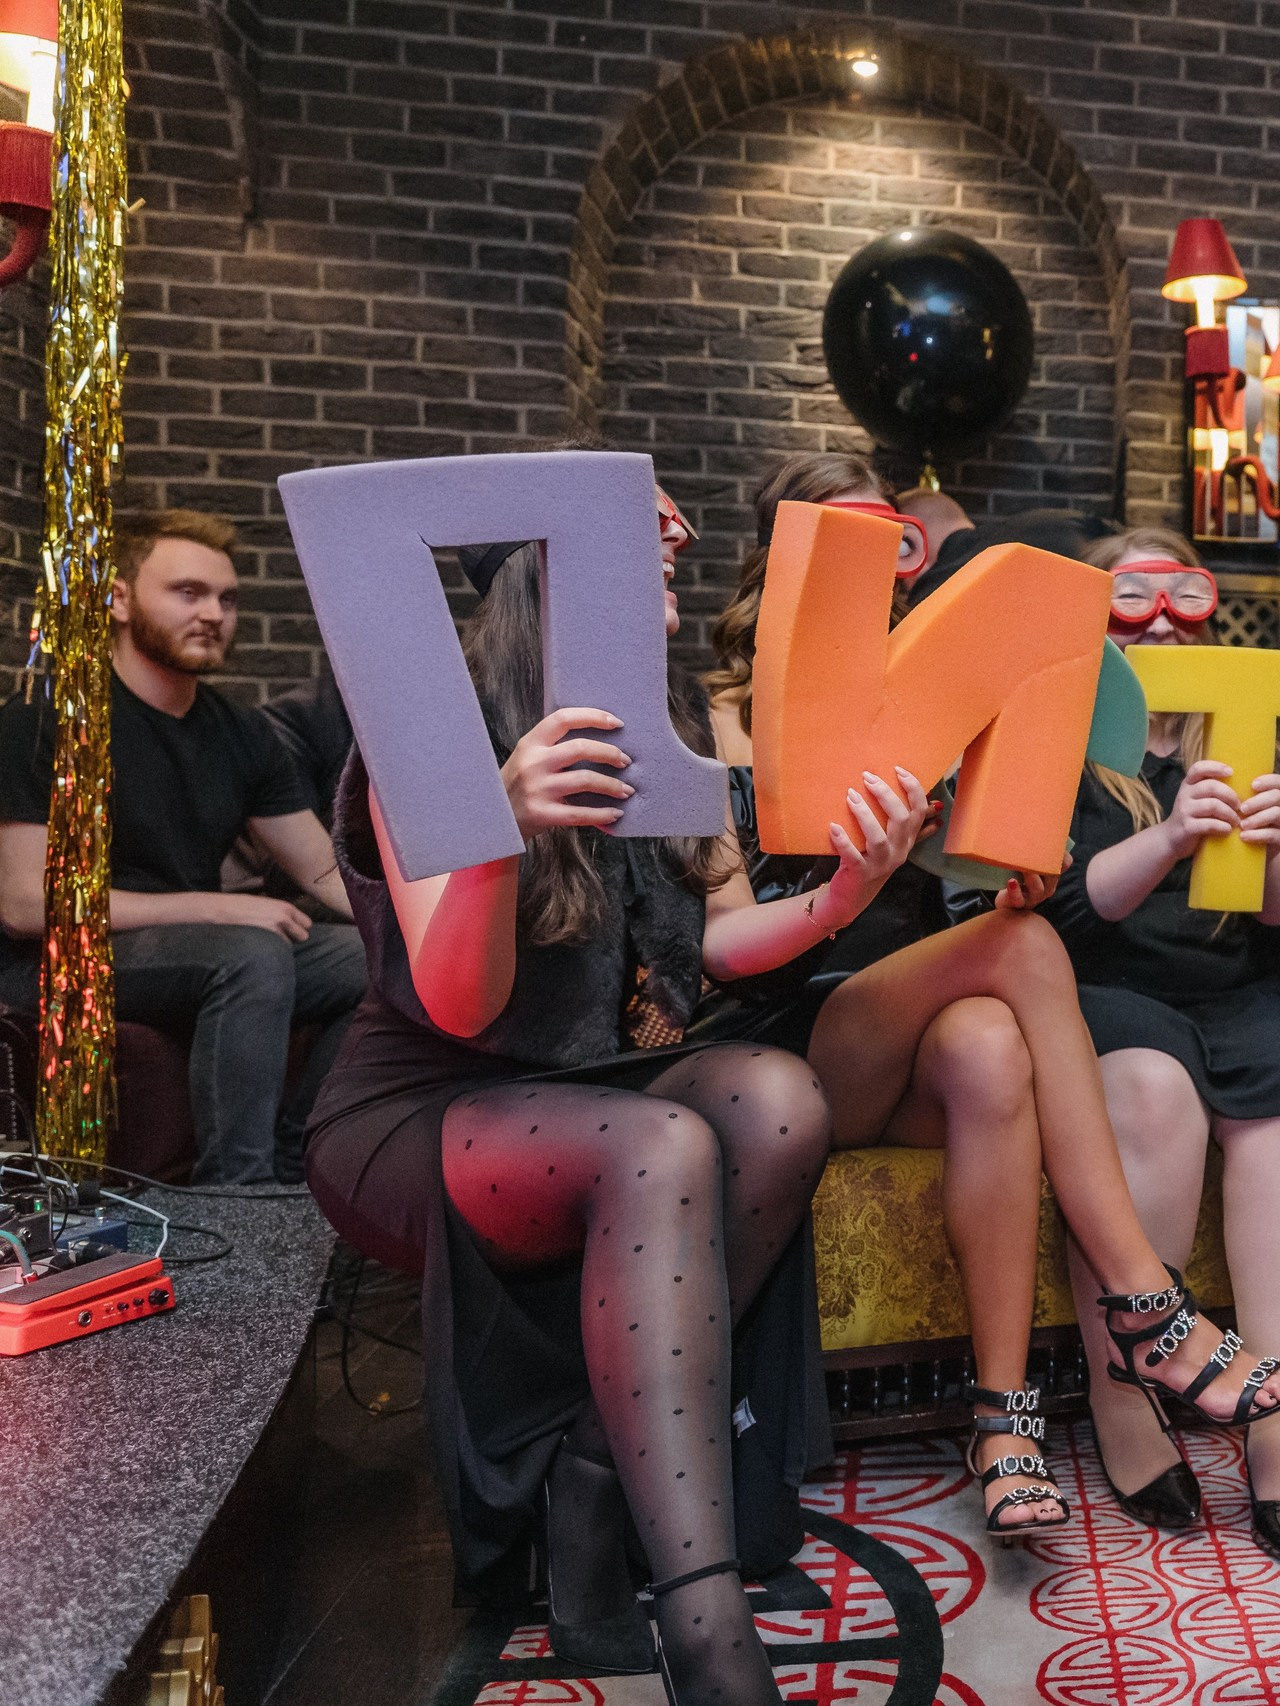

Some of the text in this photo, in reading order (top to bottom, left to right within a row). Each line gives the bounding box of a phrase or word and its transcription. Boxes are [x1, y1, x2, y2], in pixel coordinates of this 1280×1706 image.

[1127, 1286, 1180, 1313] 100%
[1152, 1308, 1198, 1361] 100%
[1003, 1387, 1041, 1412] 100
[993, 1454, 1048, 1478] 100%
